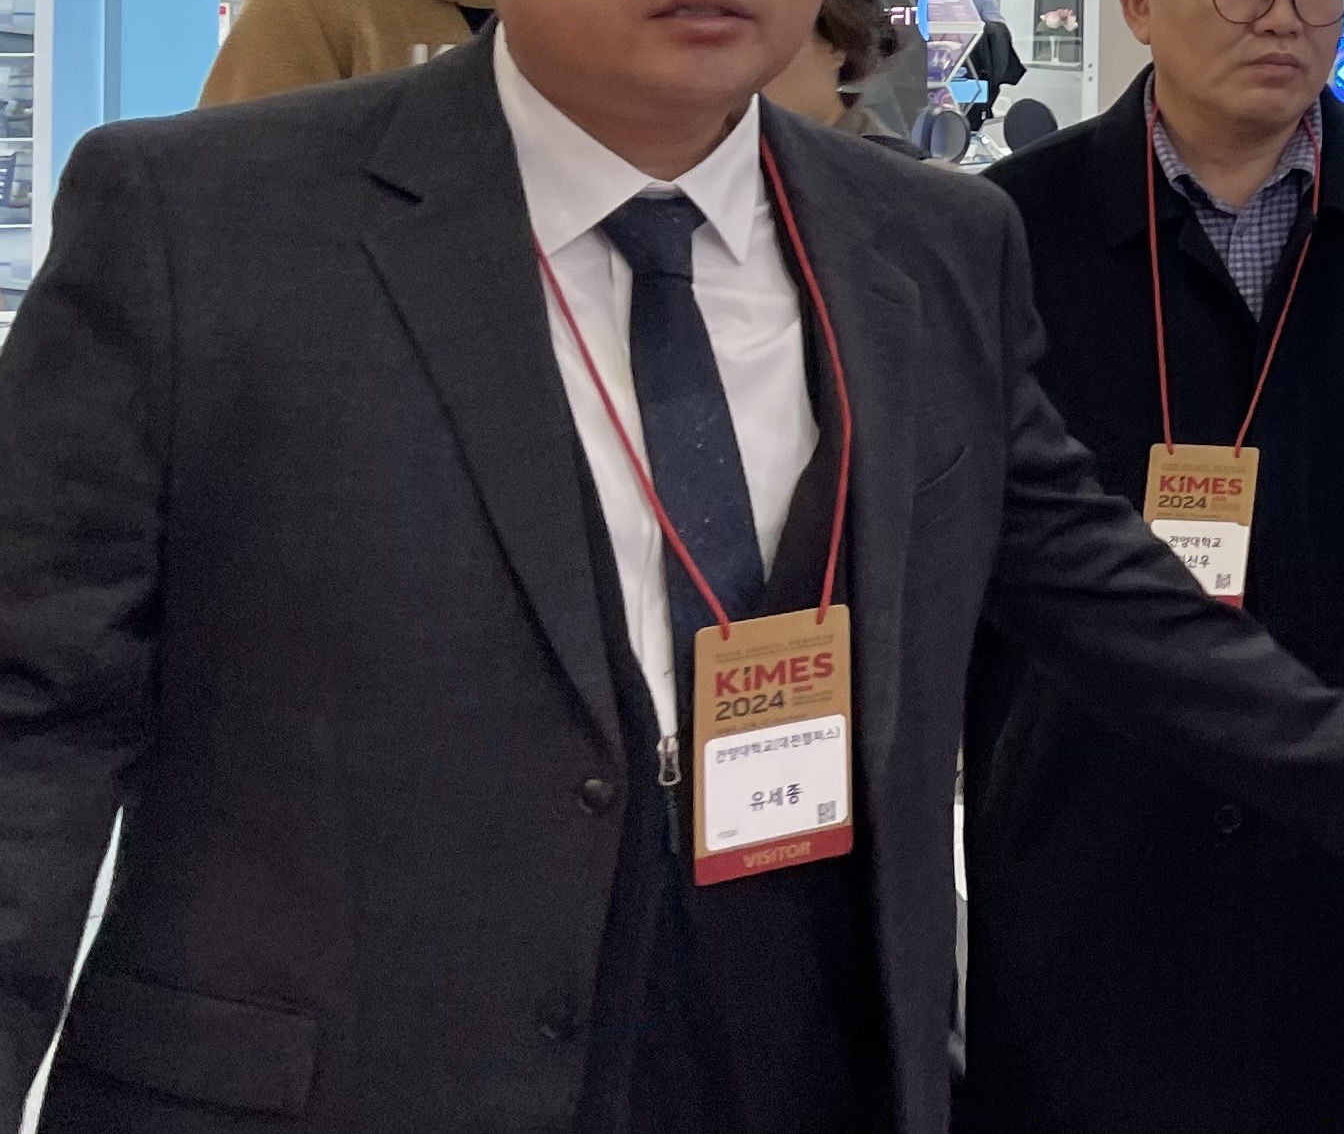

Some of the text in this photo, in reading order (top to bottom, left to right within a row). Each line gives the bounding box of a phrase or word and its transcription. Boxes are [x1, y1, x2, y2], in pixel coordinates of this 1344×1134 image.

[1157, 495, 1207, 509] 2024
[714, 689, 785, 722] 2024
[743, 839, 812, 868] VISITOR
